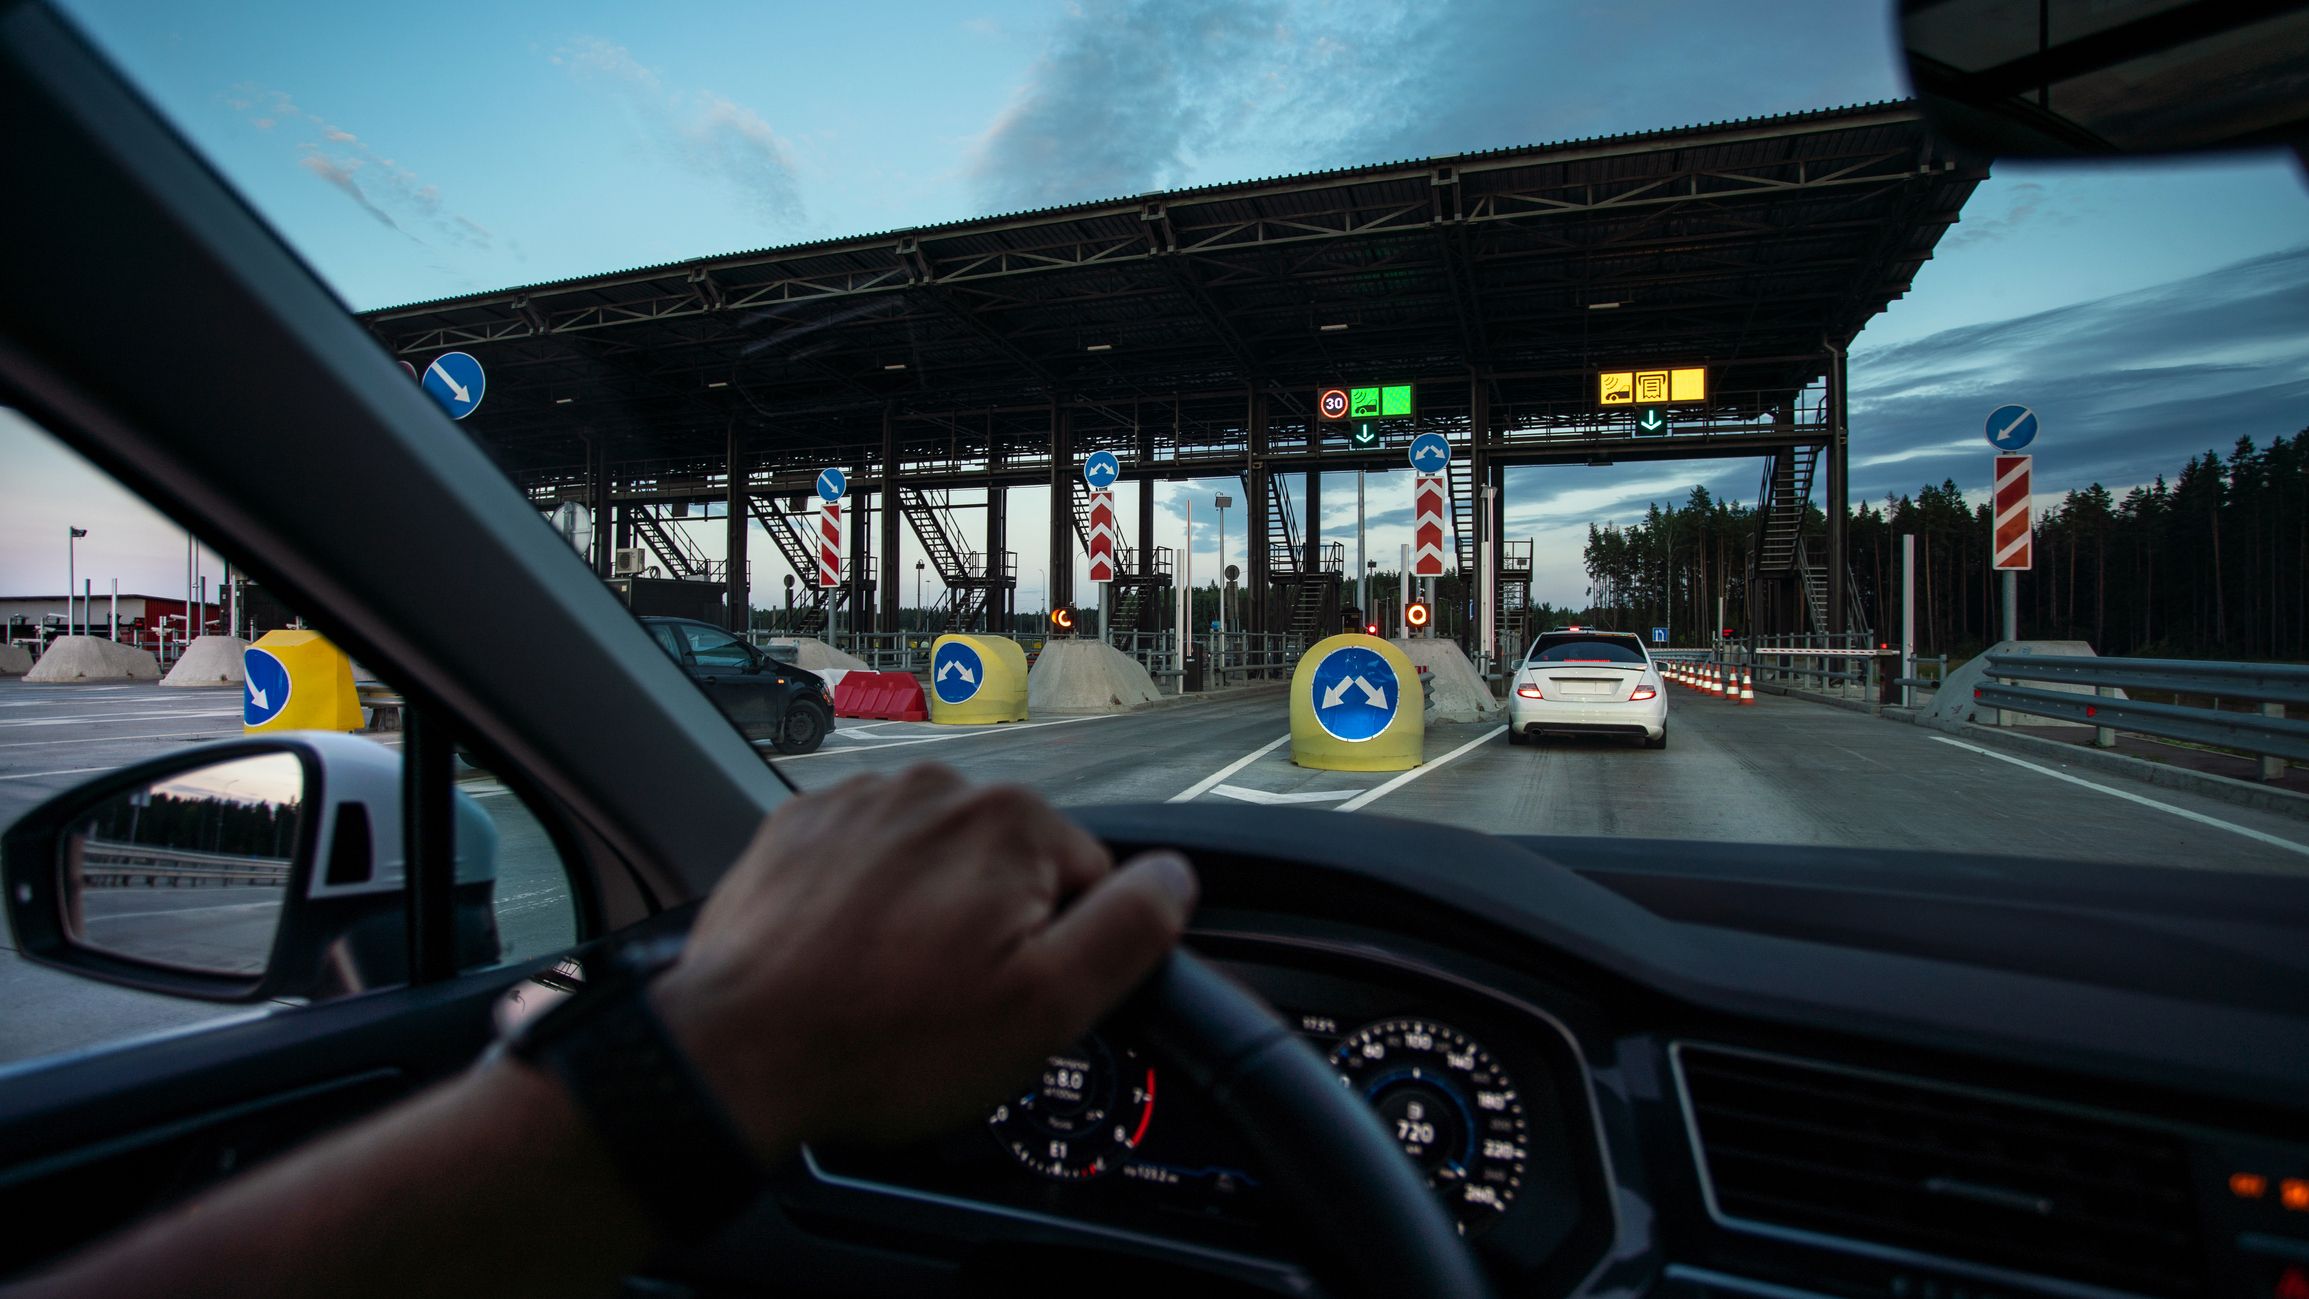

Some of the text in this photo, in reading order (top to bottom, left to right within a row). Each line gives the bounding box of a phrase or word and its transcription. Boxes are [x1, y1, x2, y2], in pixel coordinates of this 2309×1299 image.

[1325, 397, 1343, 410] 30
[1404, 1031, 1433, 1051] 100
[1446, 1051, 1475, 1072] 140
[1057, 1068, 1084, 1089] 8.0
[1132, 1085, 1144, 1104] 7
[997, 1104, 1010, 1122] 0
[1396, 1118, 1436, 1144] 720
[1049, 1139, 1068, 1159] E1
[1482, 1137, 1515, 1161] 220
